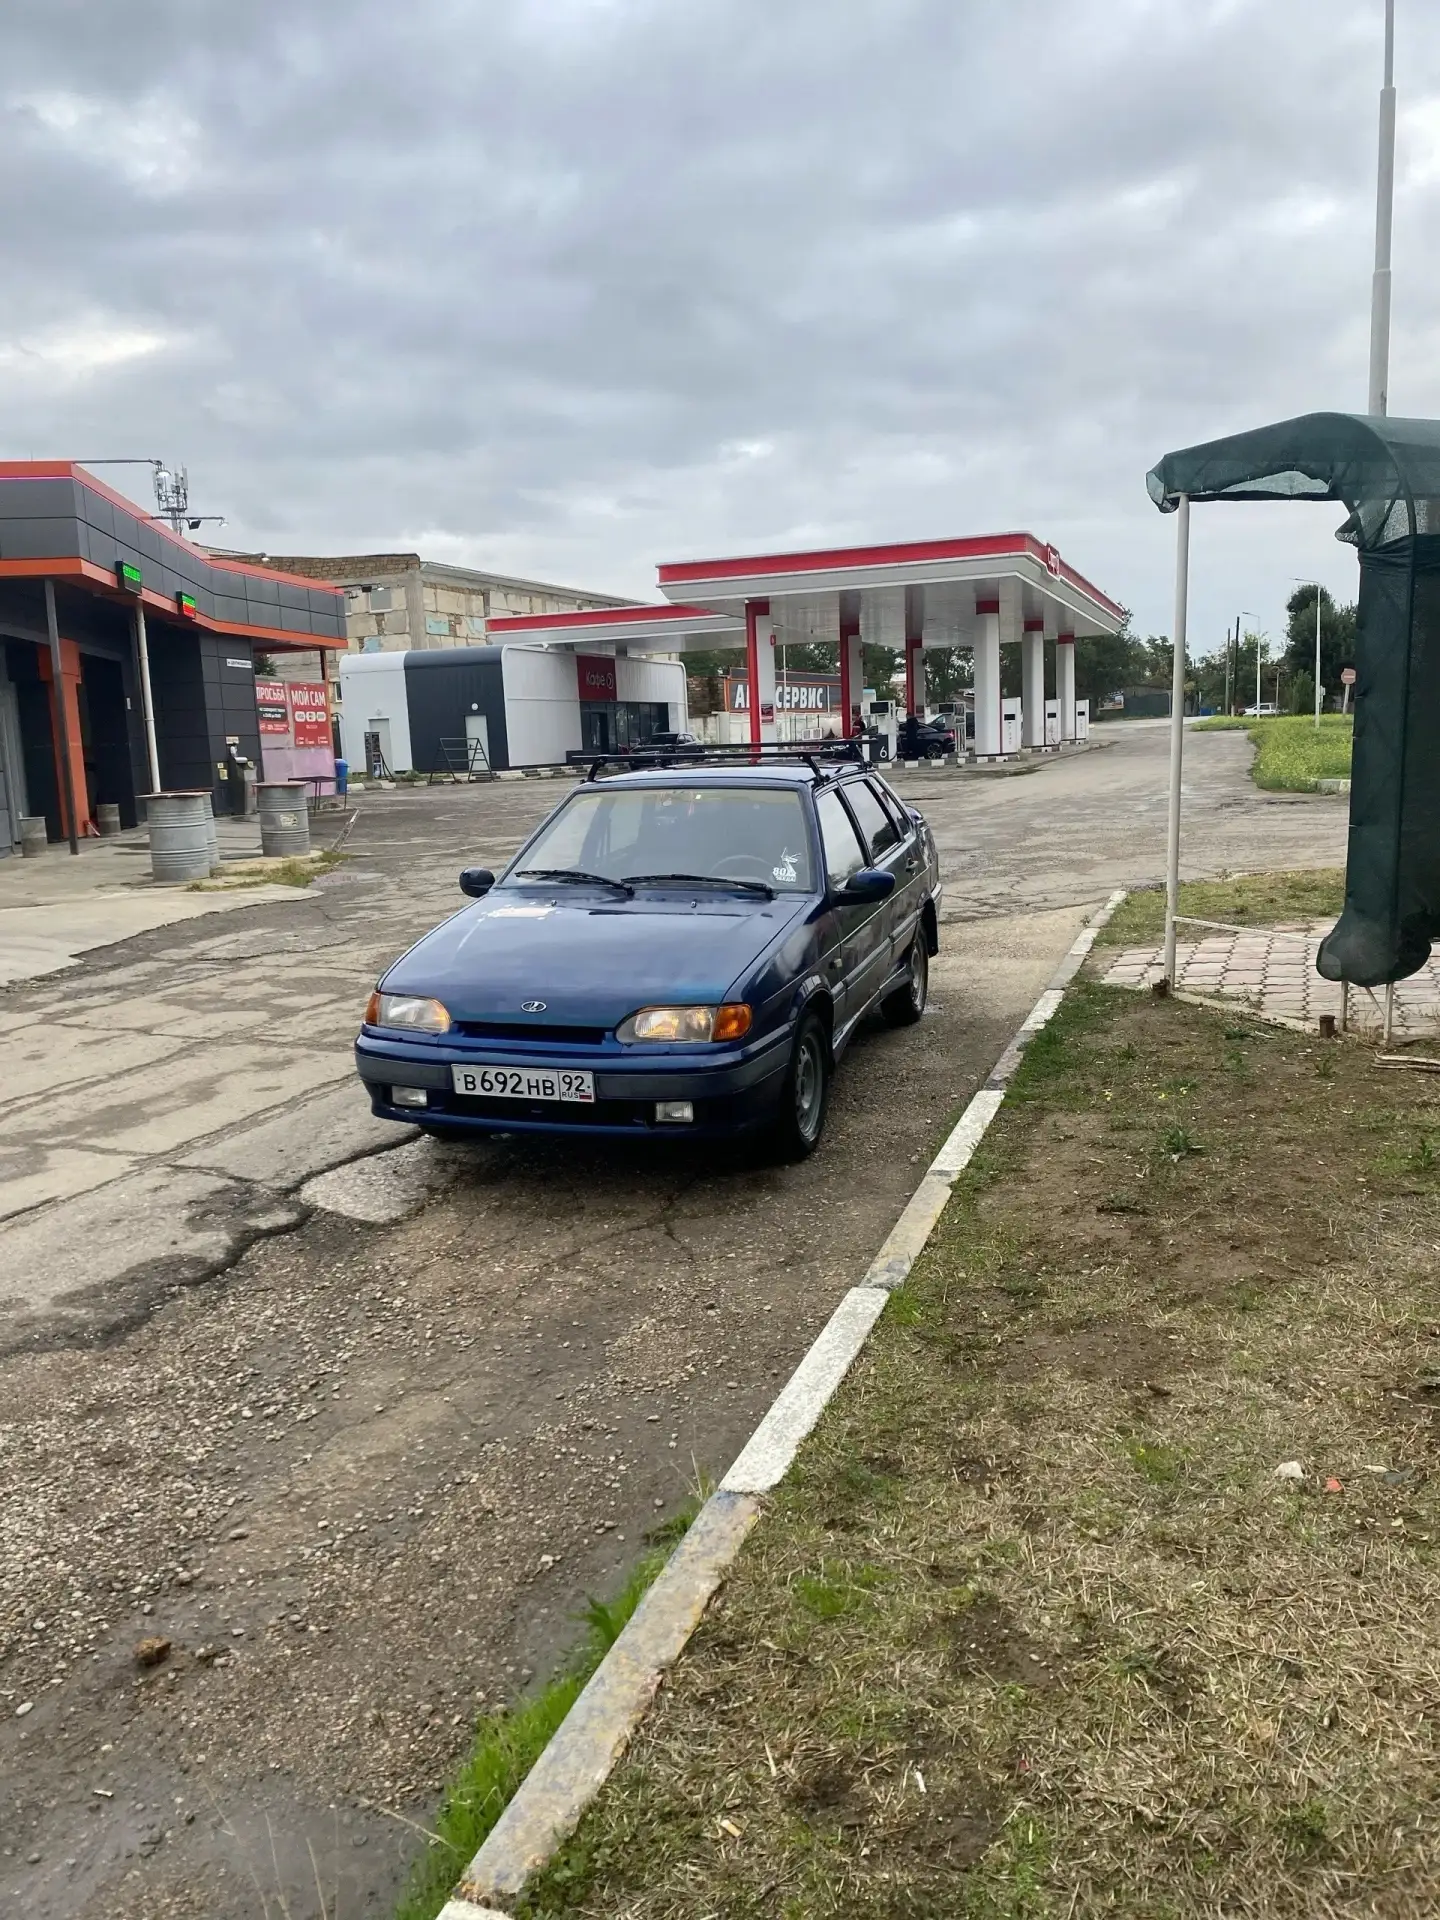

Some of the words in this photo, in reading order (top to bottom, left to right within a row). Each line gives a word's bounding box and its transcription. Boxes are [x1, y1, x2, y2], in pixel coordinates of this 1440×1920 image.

[586, 670, 606, 688] Кафе
[256, 686, 286, 701] ПРОСЬБА
[291, 686, 309, 706] МОЙ
[310, 690, 326, 706] САМ
[879, 746, 887, 758] 6
[562, 1074, 586, 1092] 92
[561, 1091, 579, 1099] RUS
